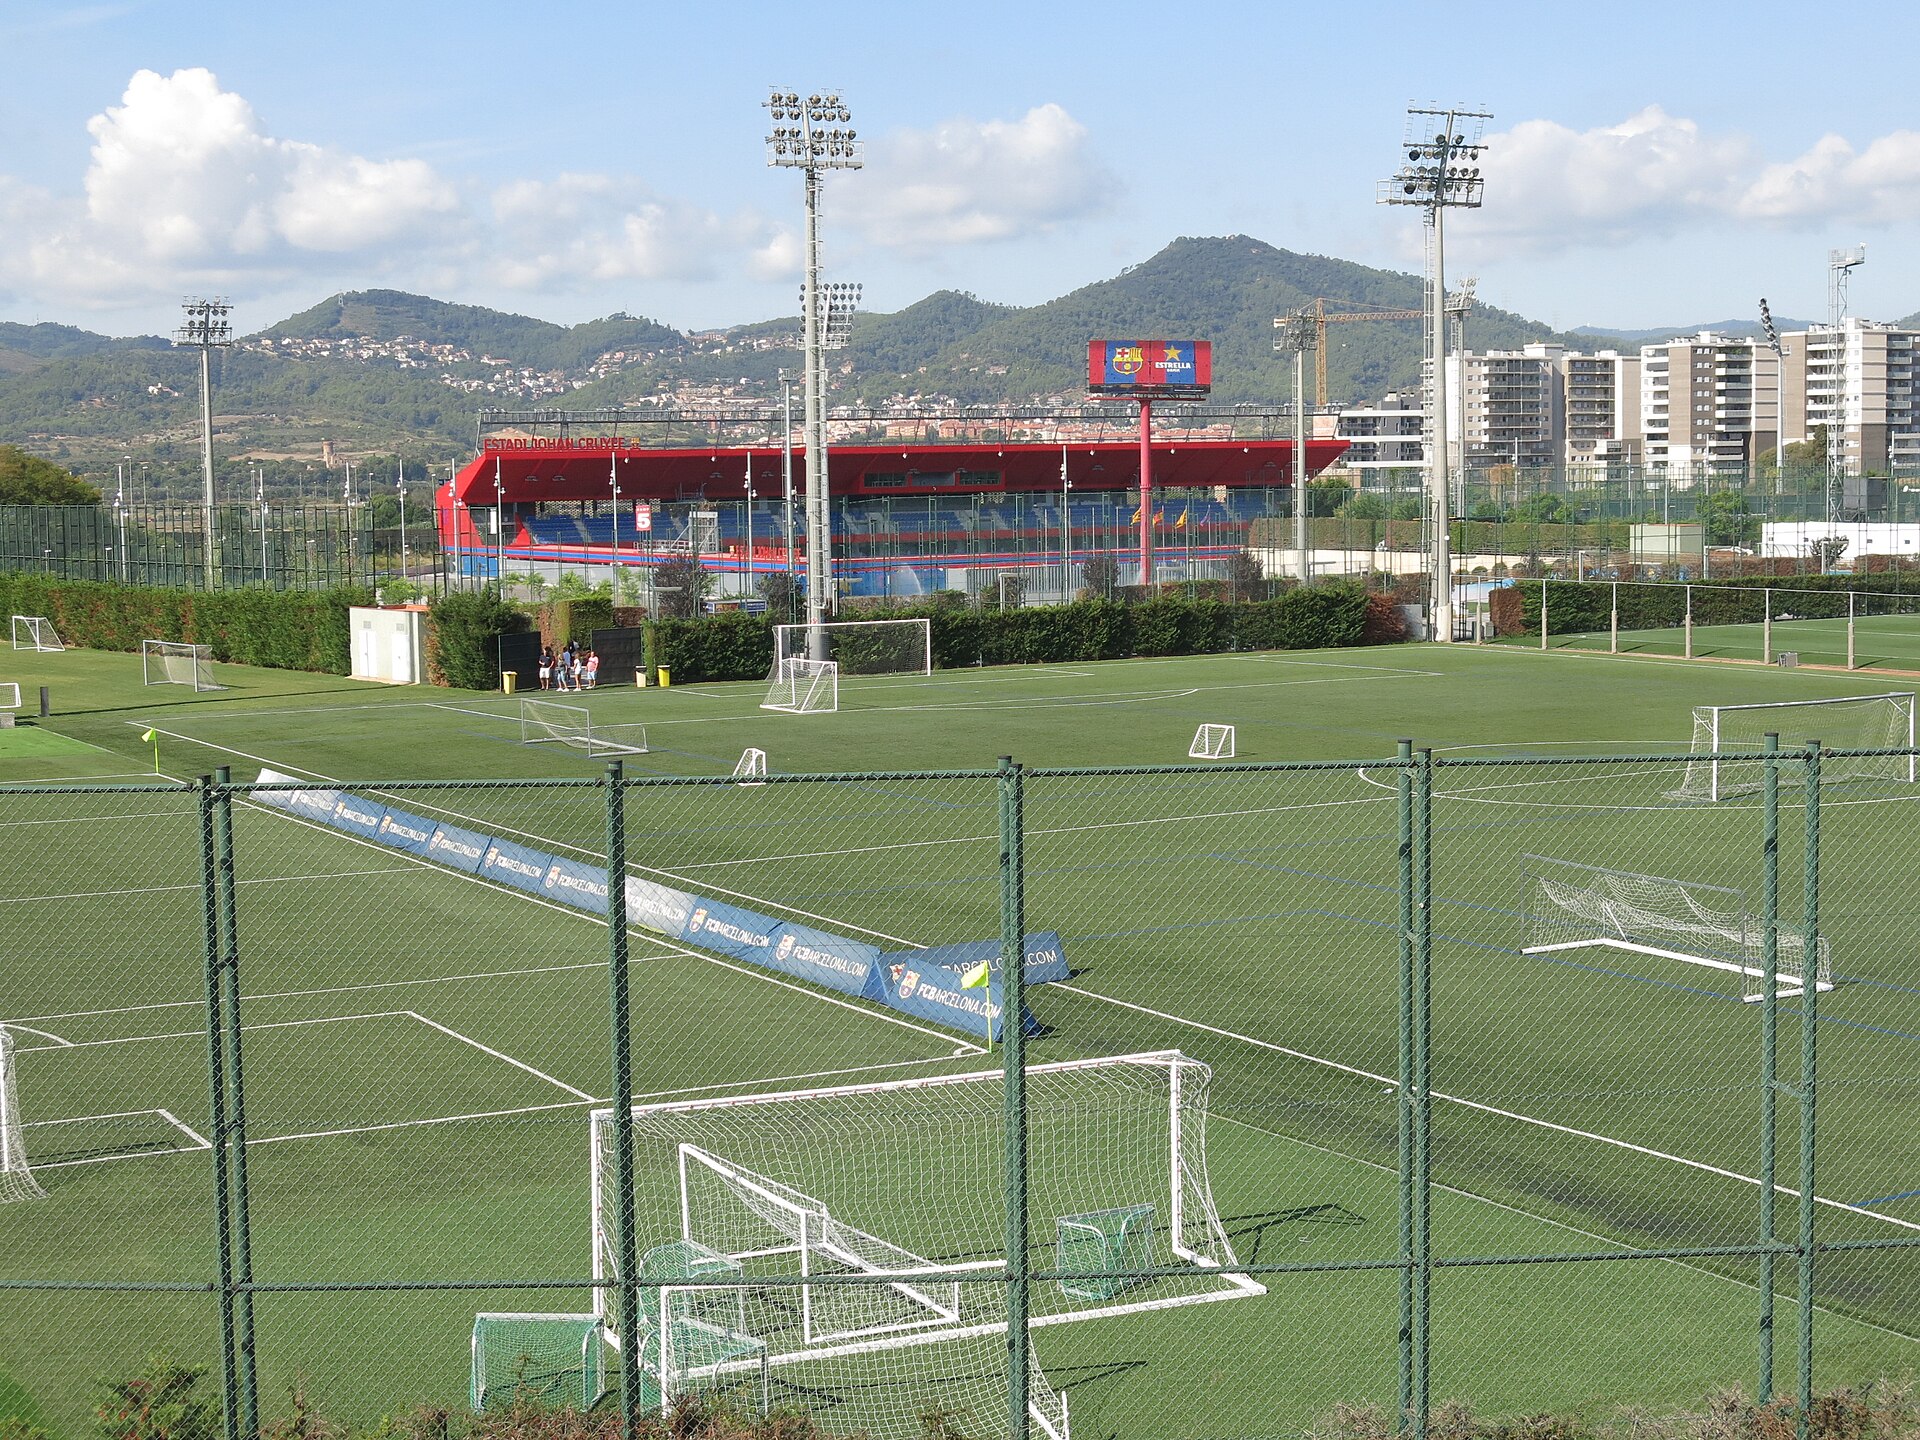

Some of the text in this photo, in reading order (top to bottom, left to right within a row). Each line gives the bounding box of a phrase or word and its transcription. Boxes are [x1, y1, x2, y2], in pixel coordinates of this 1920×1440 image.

[484, 437, 625, 450] ESTADI JOHAN CRUYFF
[637, 512, 650, 529] 5
[494, 855, 543, 878] FCBARCELONA.COM
[703, 917, 771, 947] FCBARCELONA.COM
[792, 945, 868, 977] FCBARCELONA.COM
[916, 982, 1002, 1019] FCBARCELONA.COM
